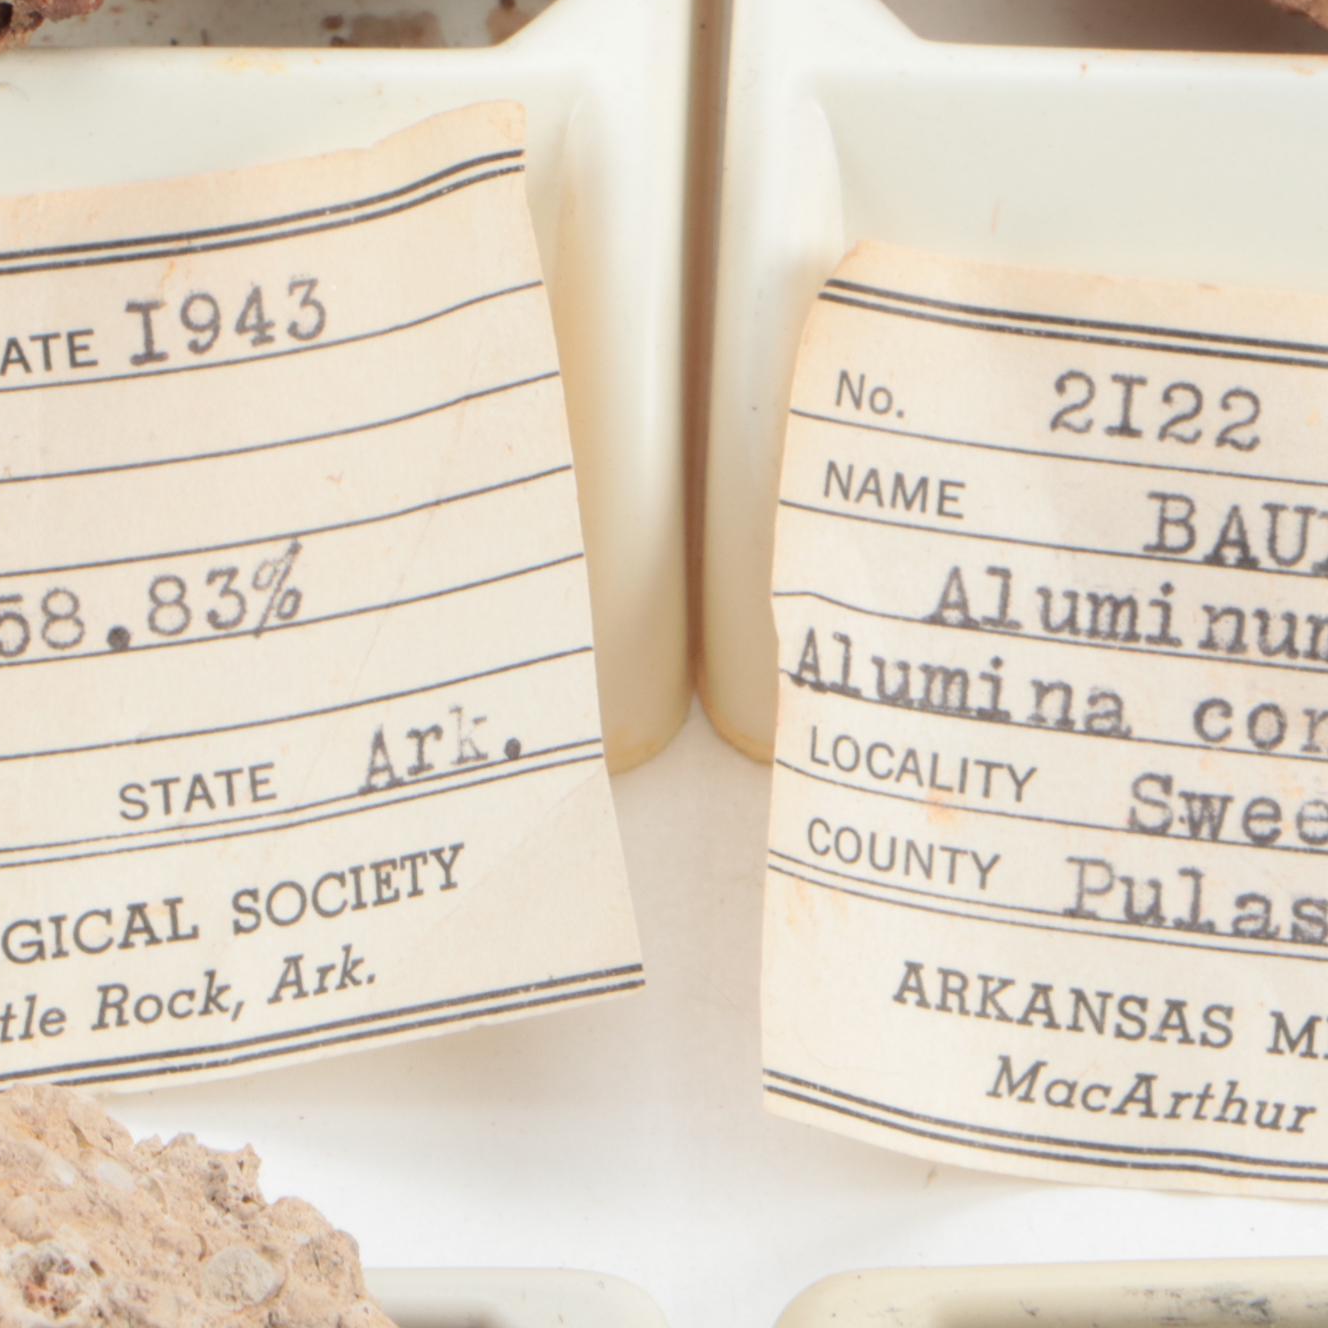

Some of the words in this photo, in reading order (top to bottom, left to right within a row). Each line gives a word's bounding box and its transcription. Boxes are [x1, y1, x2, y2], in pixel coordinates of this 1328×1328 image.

[834, 370, 905, 417] No.
[823, 460, 967, 519] NAME
[790, 628, 1131, 737] Alumina
[119, 761, 279, 822] STATE
[358, 706, 524, 796] Ark.
[808, 725, 1036, 802] LOCALITY
[232, 843, 467, 936] SOCIETY
[806, 817, 1002, 890] COUNTY
[91, 970, 246, 1031] Rock,
[266, 944, 378, 1004] Ark.
[893, 960, 1234, 1048] ARKANSAS
[986, 1055, 1316, 1135] MacArthur
